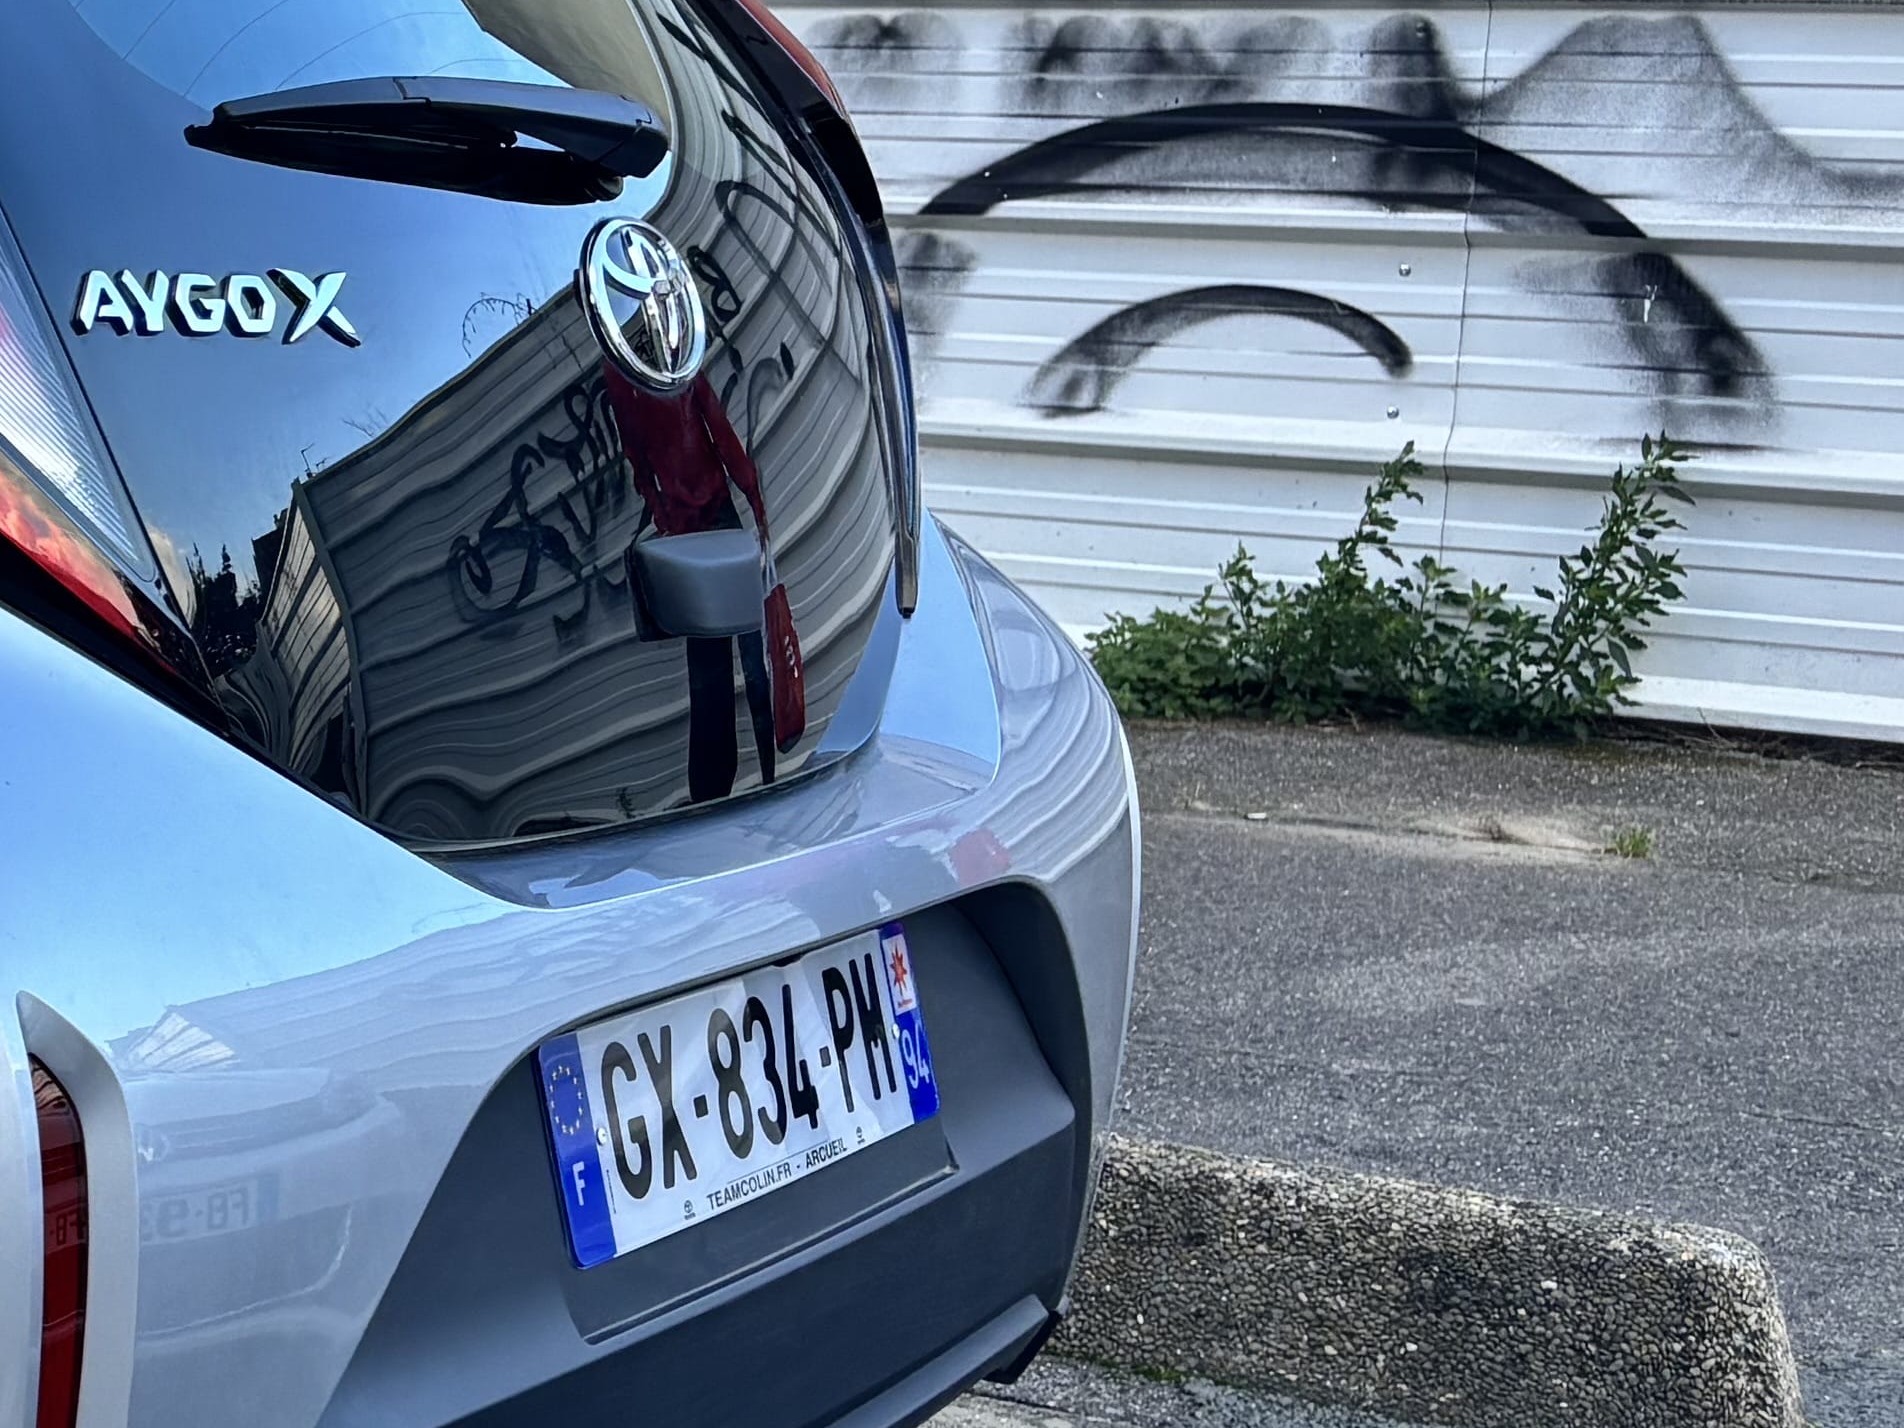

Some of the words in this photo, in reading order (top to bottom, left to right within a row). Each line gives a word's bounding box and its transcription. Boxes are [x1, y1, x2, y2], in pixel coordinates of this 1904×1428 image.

[601, 953, 898, 1200] GX-834-PM
[901, 1019, 931, 1089] 94
[572, 1160, 586, 1207] F
[706, 1162, 792, 1211] TEAMCOLIN.FR
[805, 1138, 848, 1170] ARCUEIL
